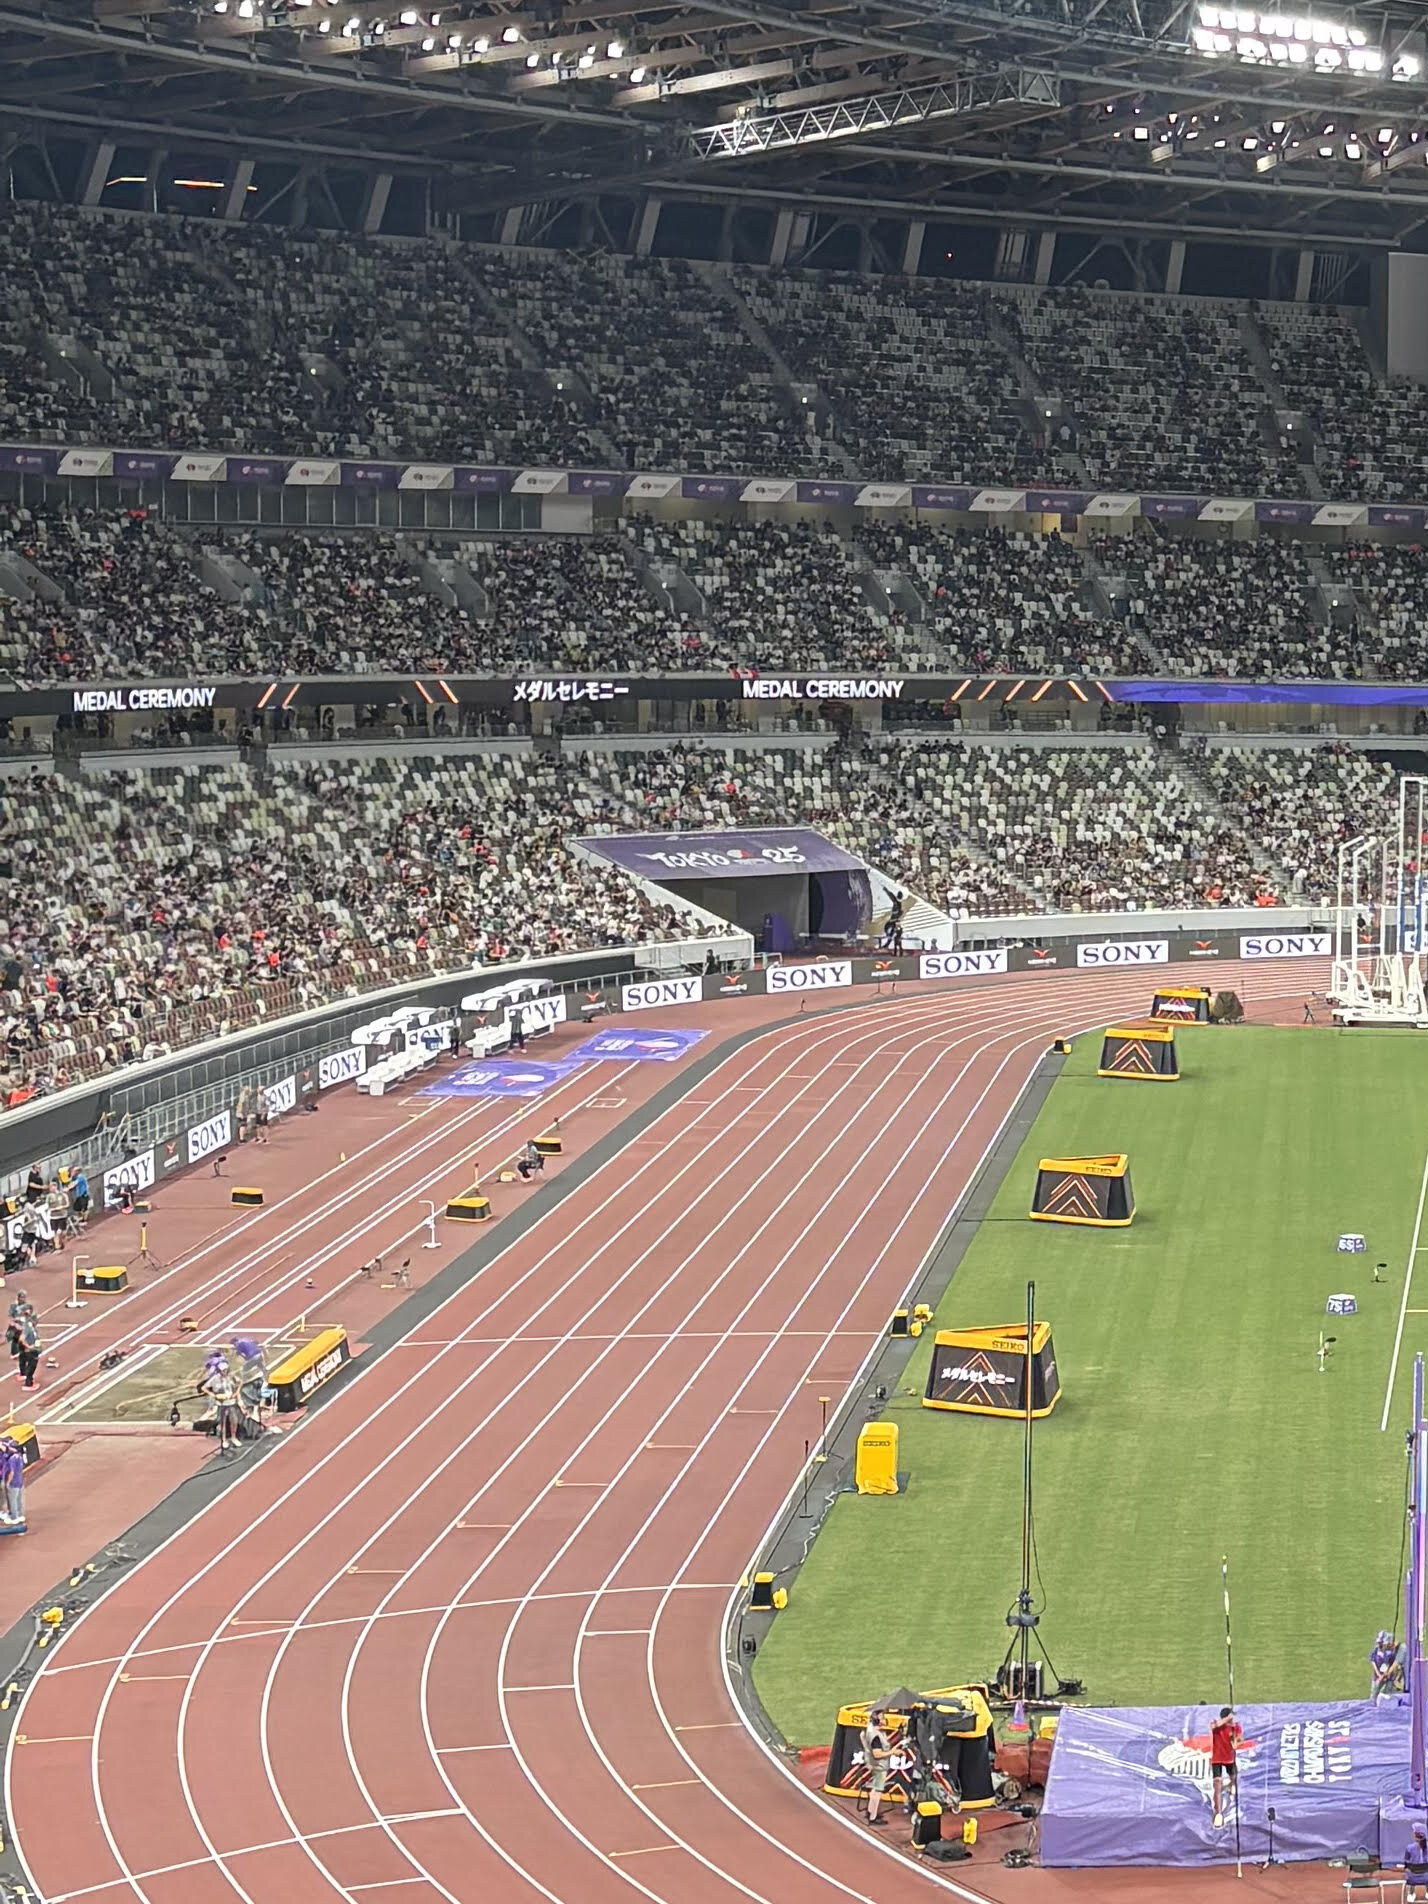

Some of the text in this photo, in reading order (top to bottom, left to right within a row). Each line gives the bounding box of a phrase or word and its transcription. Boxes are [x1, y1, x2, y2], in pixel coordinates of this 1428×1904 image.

[73, 687, 216, 712] MEDAL CEREMONY
[513, 679, 630, 701] メダルセレモニー
[742, 679, 905, 699] MEDAL CEREMONY
[1083, 944, 1163, 964] SONY
[1246, 937, 1325, 956] SONY
[771, 963, 847, 989] SONY
[925, 953, 1001, 976] SONY
[627, 981, 698, 1007] SONY
[319, 1049, 362, 1084] SONY
[190, 1117, 229, 1156] SONY
[992, 1340, 1025, 1352] SEIKO
